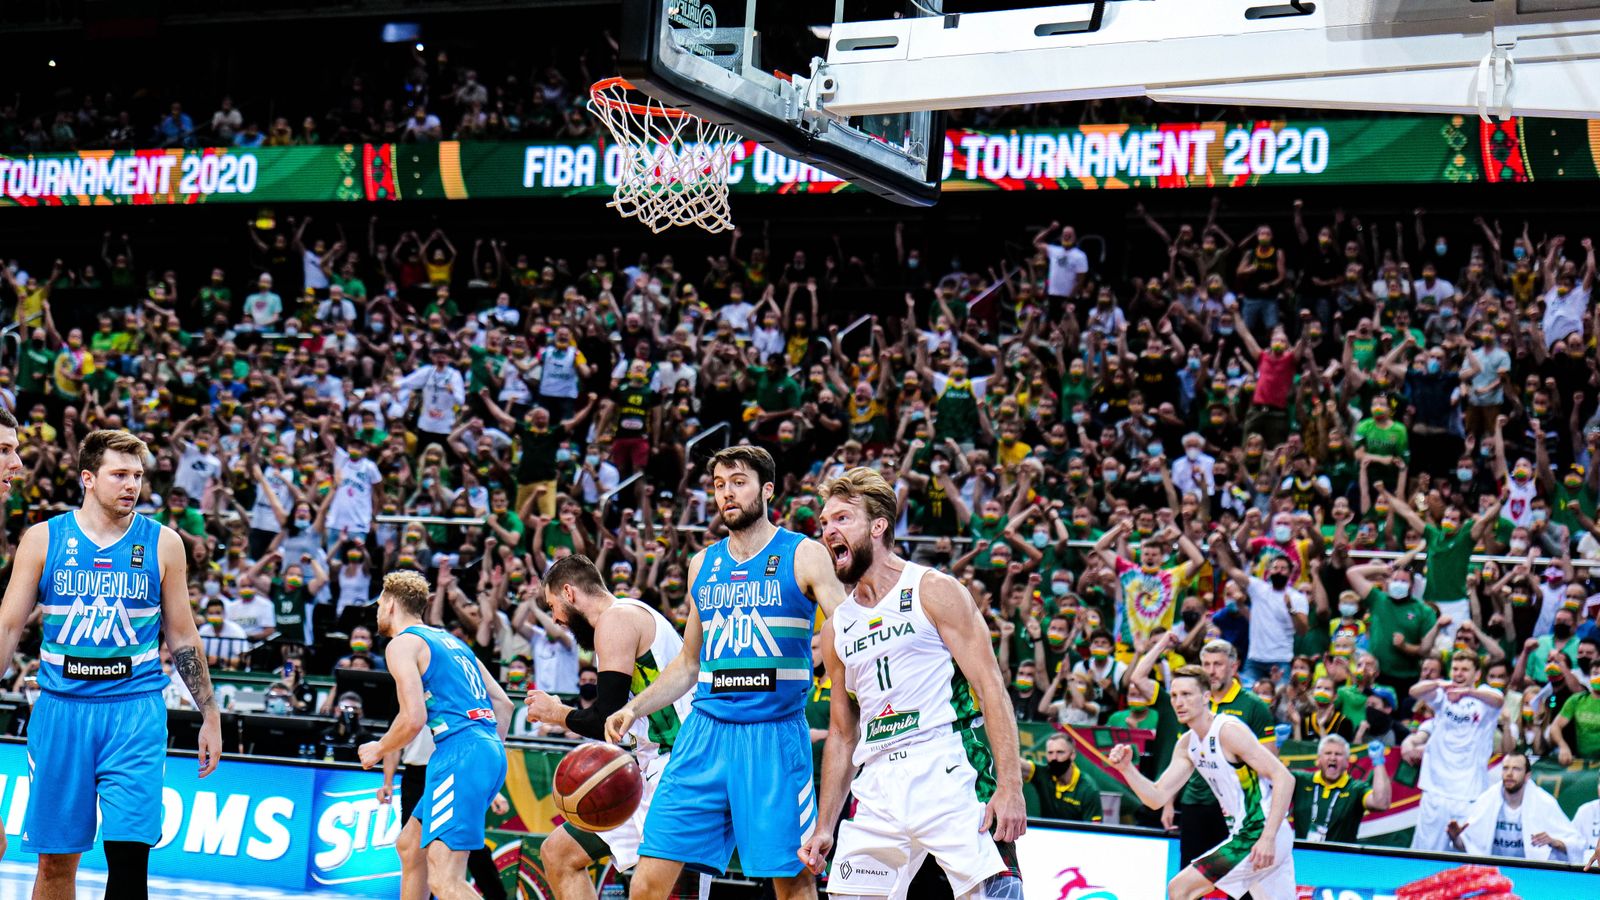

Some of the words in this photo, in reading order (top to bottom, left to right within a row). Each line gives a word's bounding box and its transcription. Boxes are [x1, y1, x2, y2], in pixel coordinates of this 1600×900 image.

[523, 145, 598, 188] FIBA
[960, 130, 1216, 180] TOURNAMENT
[1223, 128, 1330, 175] 2020
[181, 154, 258, 195] 2020
[54, 569, 148, 600] SLOVENIJA
[698, 579, 782, 612] SLOVENIJA
[83, 605, 117, 639] 77
[727, 614, 752, 648] 10
[845, 622, 916, 658] LIETUVA
[67, 661, 127, 676] telemach
[876, 656, 893, 692] 11
[889, 751, 907, 762] LTU
[855, 868, 889, 877] RENAULT
